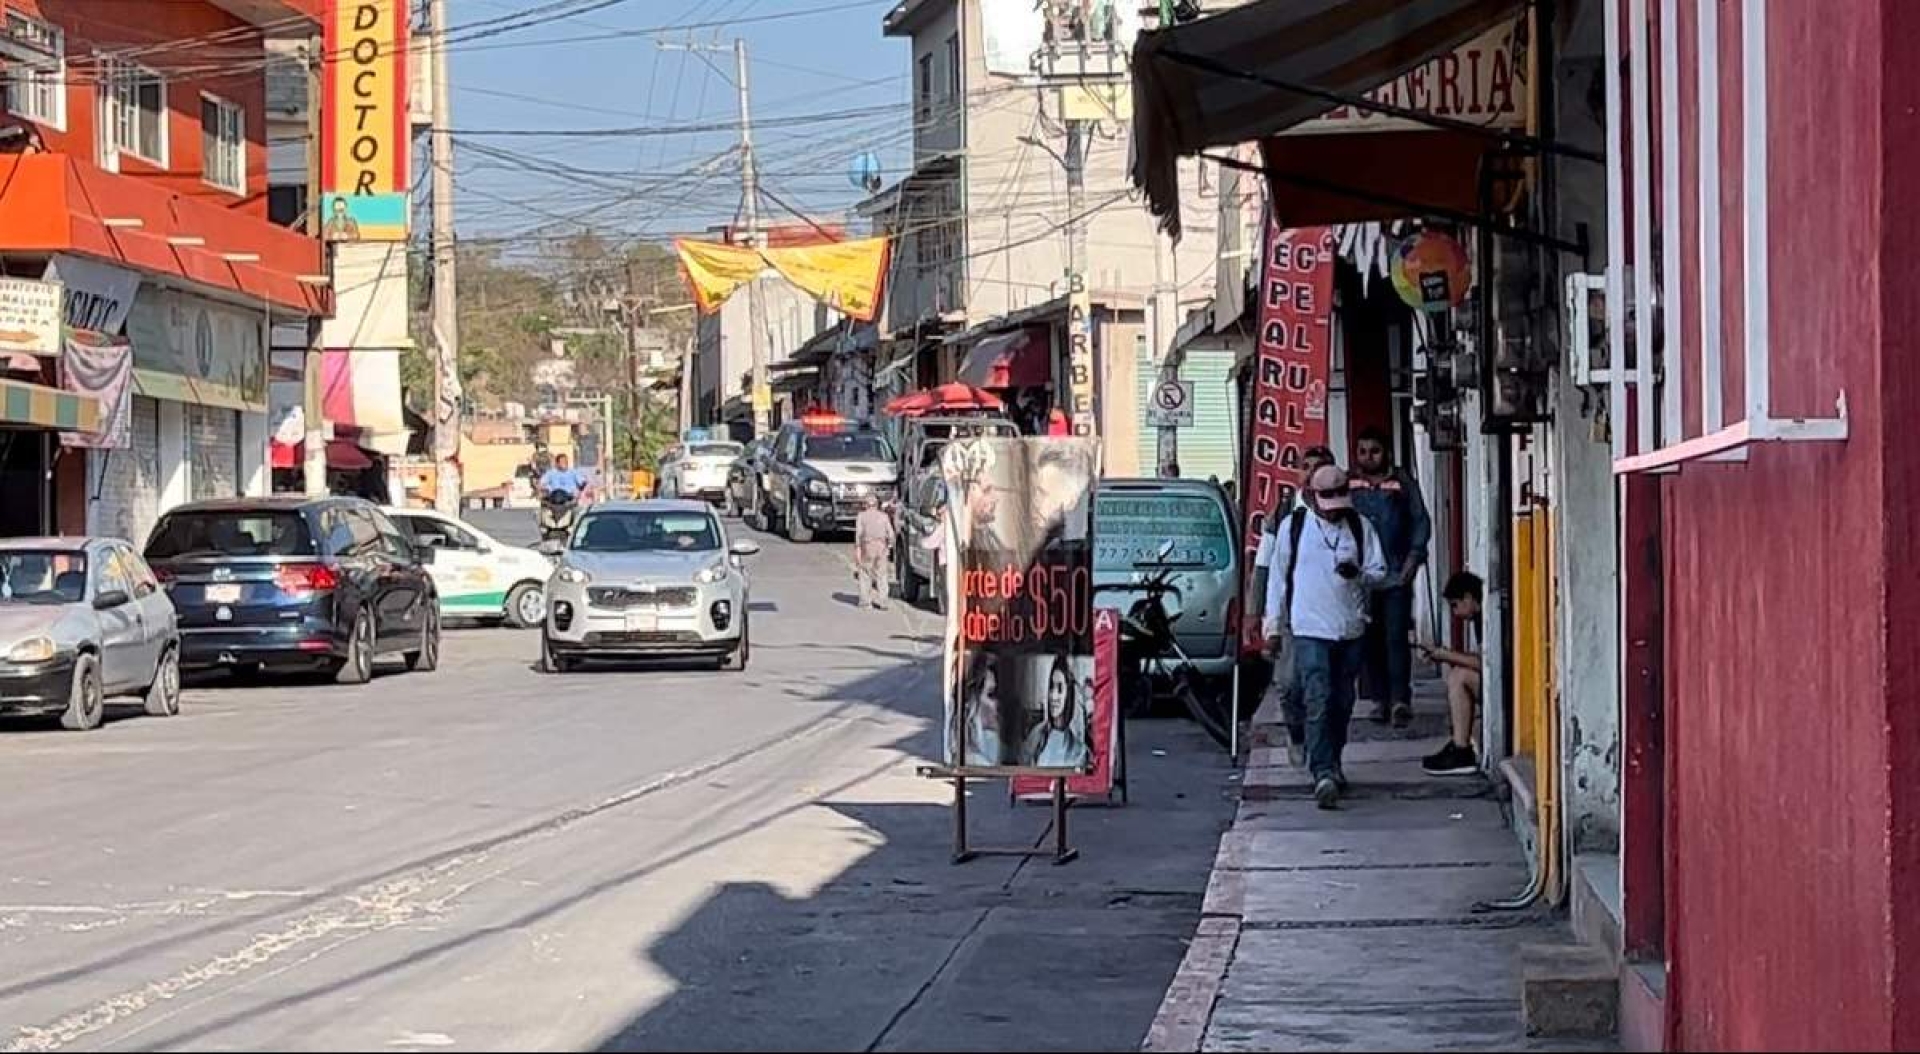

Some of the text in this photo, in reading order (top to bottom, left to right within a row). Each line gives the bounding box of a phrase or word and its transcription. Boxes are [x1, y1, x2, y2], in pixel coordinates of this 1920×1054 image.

[352, 4, 379, 196] DOCTOR
[1001, 563, 1024, 598] de
[1028, 560, 1089, 641] $50
